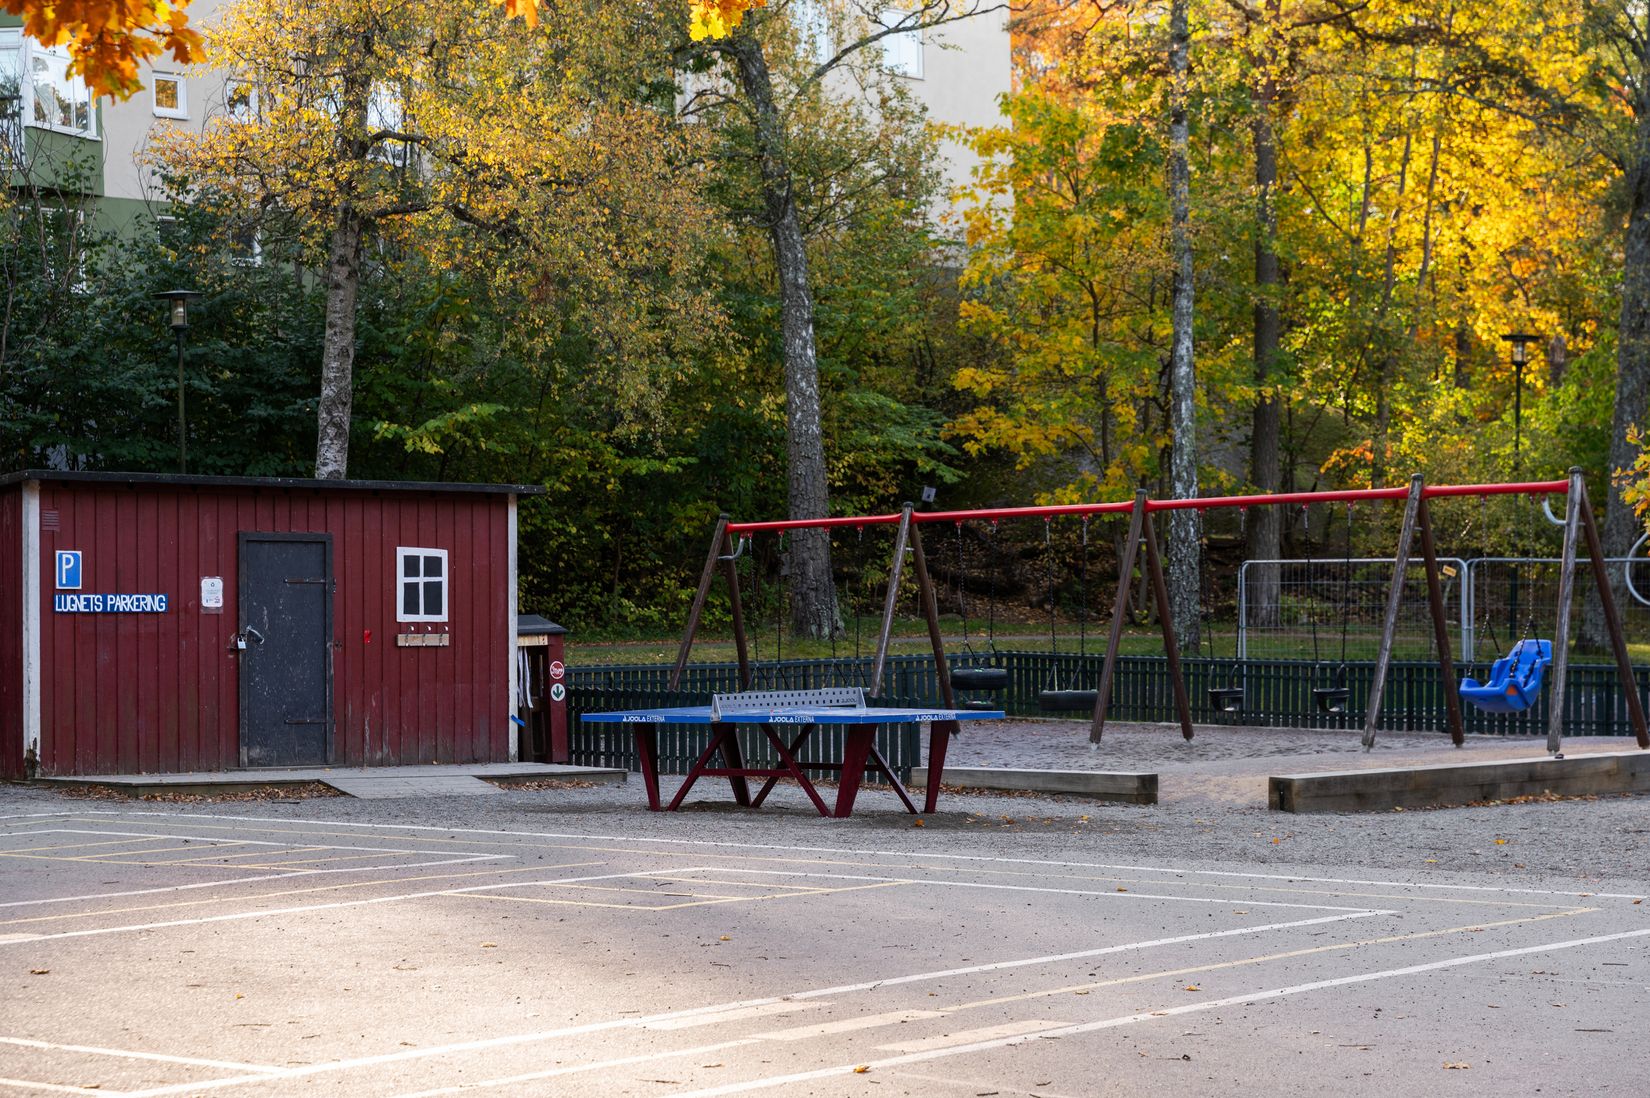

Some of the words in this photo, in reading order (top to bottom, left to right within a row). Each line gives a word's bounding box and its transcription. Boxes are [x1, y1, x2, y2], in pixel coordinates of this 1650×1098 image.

[62, 553, 75, 585] P
[55, 594, 103, 612] LUGNETS
[107, 594, 166, 612] PARKERING
